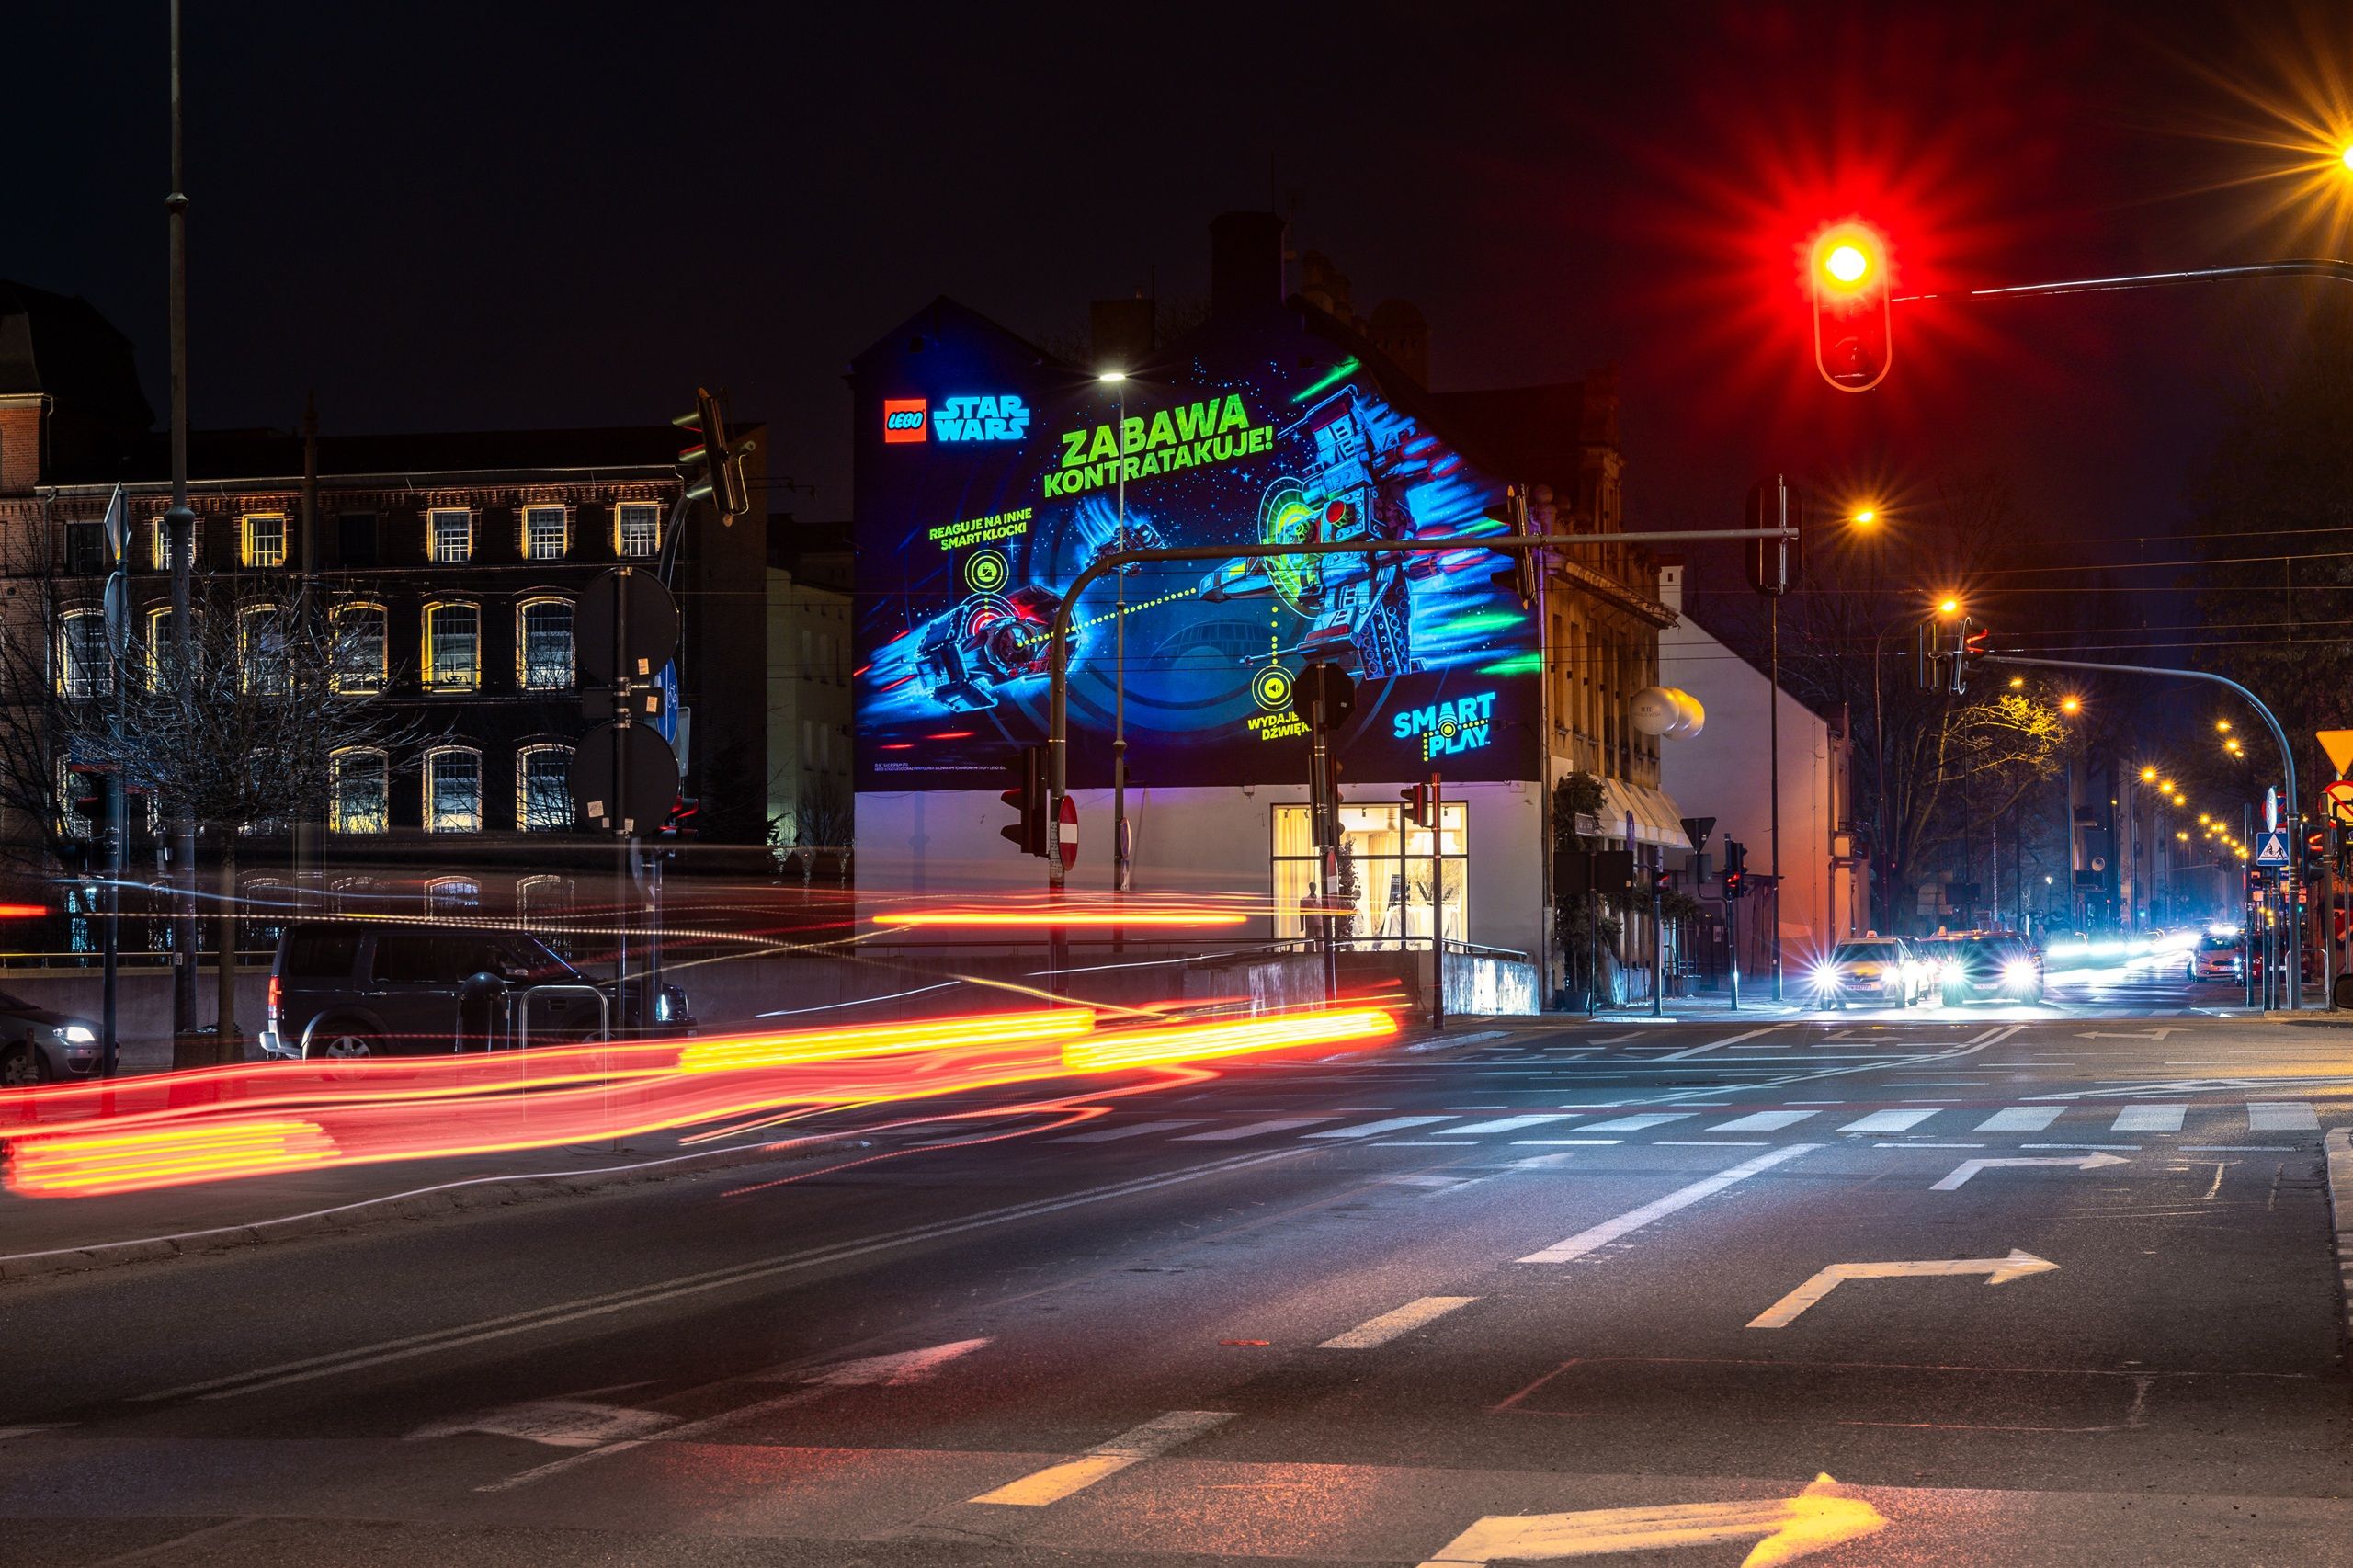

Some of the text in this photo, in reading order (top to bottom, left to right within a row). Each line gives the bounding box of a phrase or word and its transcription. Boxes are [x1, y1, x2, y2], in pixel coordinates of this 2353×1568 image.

[888, 411, 924, 429] LEGO
[934, 396, 1029, 419] STAR
[934, 418, 1029, 441] WARS
[1062, 393, 1250, 468] ZABAWA
[1043, 426, 1274, 498] KONTRATAKUJE!
[929, 507, 1032, 540] REAGUJE NA INNE
[940, 522, 1027, 551] SMART KLOCKI
[1393, 691, 1495, 738] SMART
[1429, 723, 1489, 758] PLAY
